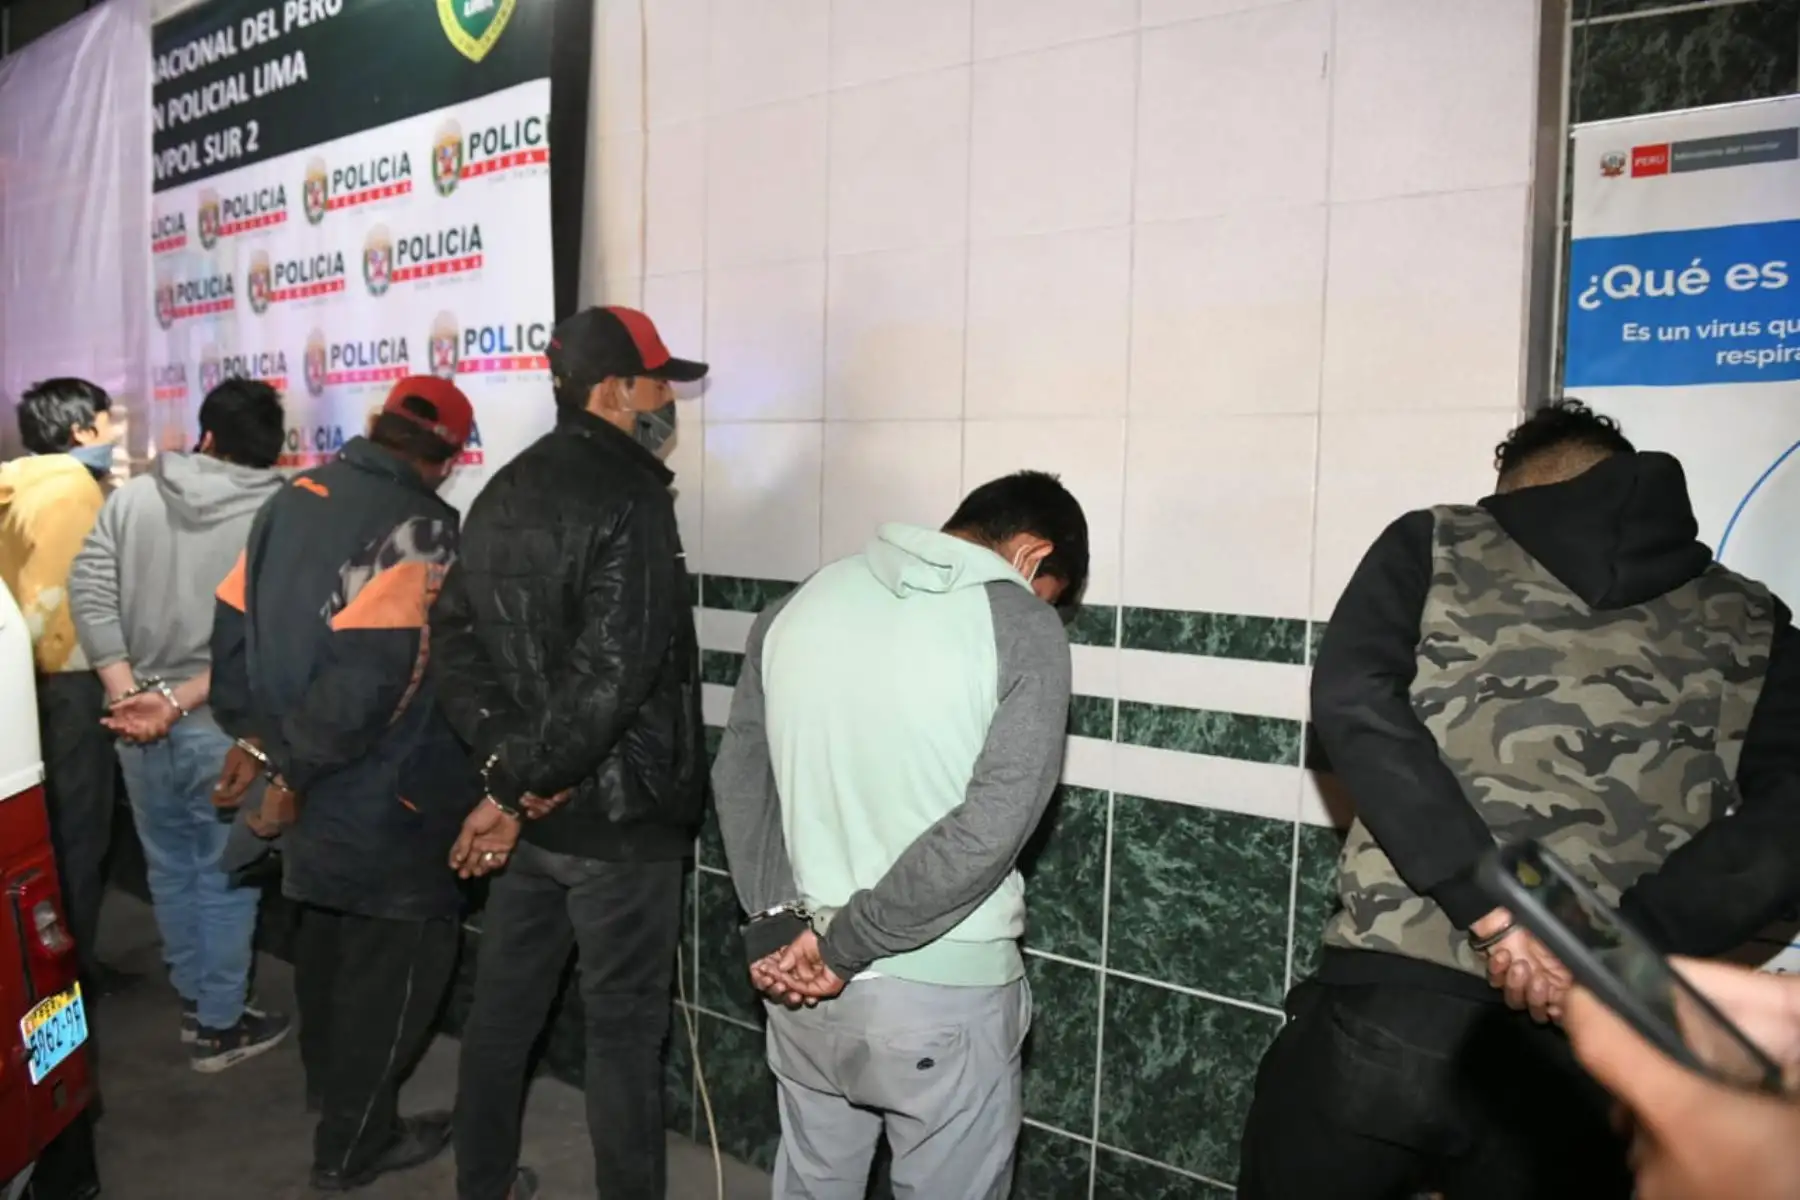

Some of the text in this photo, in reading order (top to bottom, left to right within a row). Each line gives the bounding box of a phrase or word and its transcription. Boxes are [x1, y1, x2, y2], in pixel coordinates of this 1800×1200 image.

[241, 8, 280, 50] DEL
[168, 72, 250, 128] POLICIAL
[253, 50, 308, 97] LIMA
[204, 127, 242, 165] SUR
[246, 120, 259, 152] 2
[332, 151, 411, 194] POLICIA
[222, 183, 287, 221] POLICIA
[397, 223, 482, 264] POLICIA
[275, 251, 345, 284] POLICIA
[1578, 257, 1789, 310] ¿Qué es
[177, 272, 234, 303] POLICIA
[464, 321, 554, 355] POLIC
[1622, 322, 1651, 341] Es
[1657, 323, 1690, 342] un
[1696, 319, 1761, 339] virus
[222, 350, 287, 379] POLICIA
[330, 337, 409, 369] POLICIA
